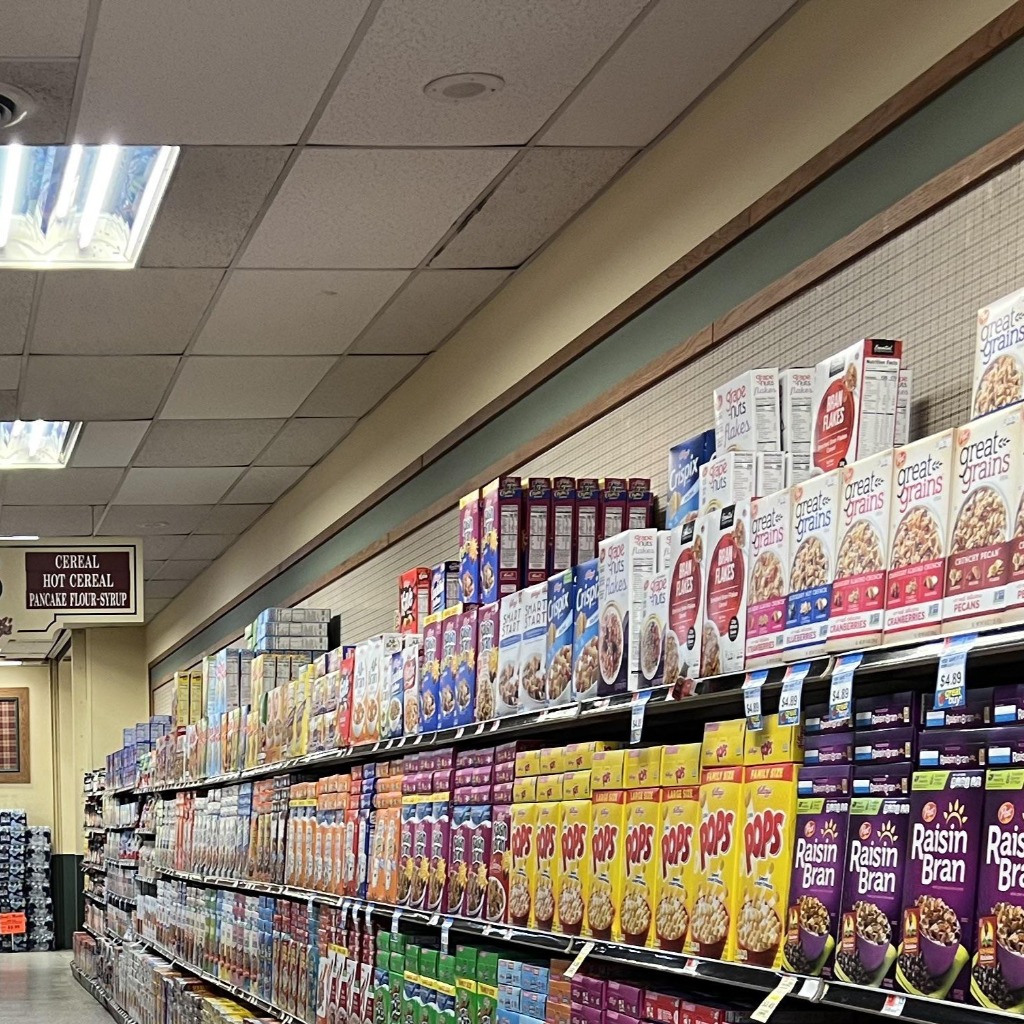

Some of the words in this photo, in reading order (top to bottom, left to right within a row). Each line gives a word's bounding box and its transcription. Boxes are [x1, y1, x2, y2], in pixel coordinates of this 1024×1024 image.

[981, 307, 1016, 342] great
[980, 325, 1024, 365] grains
[826, 389, 844, 413] BRAN
[724, 420, 751, 445] flakes
[822, 407, 846, 432] FLAKES
[959, 431, 999, 466] great
[897, 454, 933, 486] great
[958, 453, 1011, 494] grains
[844, 470, 876, 502] great
[896, 474, 943, 514] grains
[795, 491, 823, 519] great
[843, 491, 884, 526] grains
[751, 511, 777, 534] great
[794, 511, 832, 543] grains
[751, 527, 784, 556] grains
[55, 555, 100, 569] CEREAL
[679, 559, 692, 576] BRAN
[717, 545, 734, 565] BRAN
[43, 574, 65, 588] HOT
[69, 573, 114, 588] CEREAL
[676, 576, 694, 597] FLAKES
[715, 563, 735, 585] FLAKES
[29, 593, 67, 607] PANCAKE
[69, 592, 127, 607] FLOUR-SYRUP
[525, 598, 547, 615] SMART
[953, 601, 980, 612] PECANS
[503, 607, 523, 624] SMART
[525, 611, 547, 628] START
[830, 619, 867, 633] CRANBERRIES
[887, 611, 925, 627] CRANBERRIES
[501, 621, 521, 637] START
[940, 672, 962, 688] $4.89
[781, 695, 798, 708] $4.89
[832, 687, 849, 700] $4.89
[746, 702, 759, 714] $4.89
[750, 768, 768, 779] FAMILY
[536, 823, 558, 871] POPS
[561, 822, 587, 873] POPS
[592, 823, 619, 875] POPS
[624, 823, 655, 879] POPS
[661, 823, 694, 881] POPS
[699, 809, 736, 874] POPS
[744, 808, 786, 878] POPS
[795, 835, 838, 869] Raisin
[911, 823, 968, 860] Raisin
[849, 840, 899, 873] Raisin
[802, 863, 836, 889] Bran
[858, 867, 896, 894] Bran
[921, 856, 966, 885] Bran
[998, 857, 1024, 892] Bra
